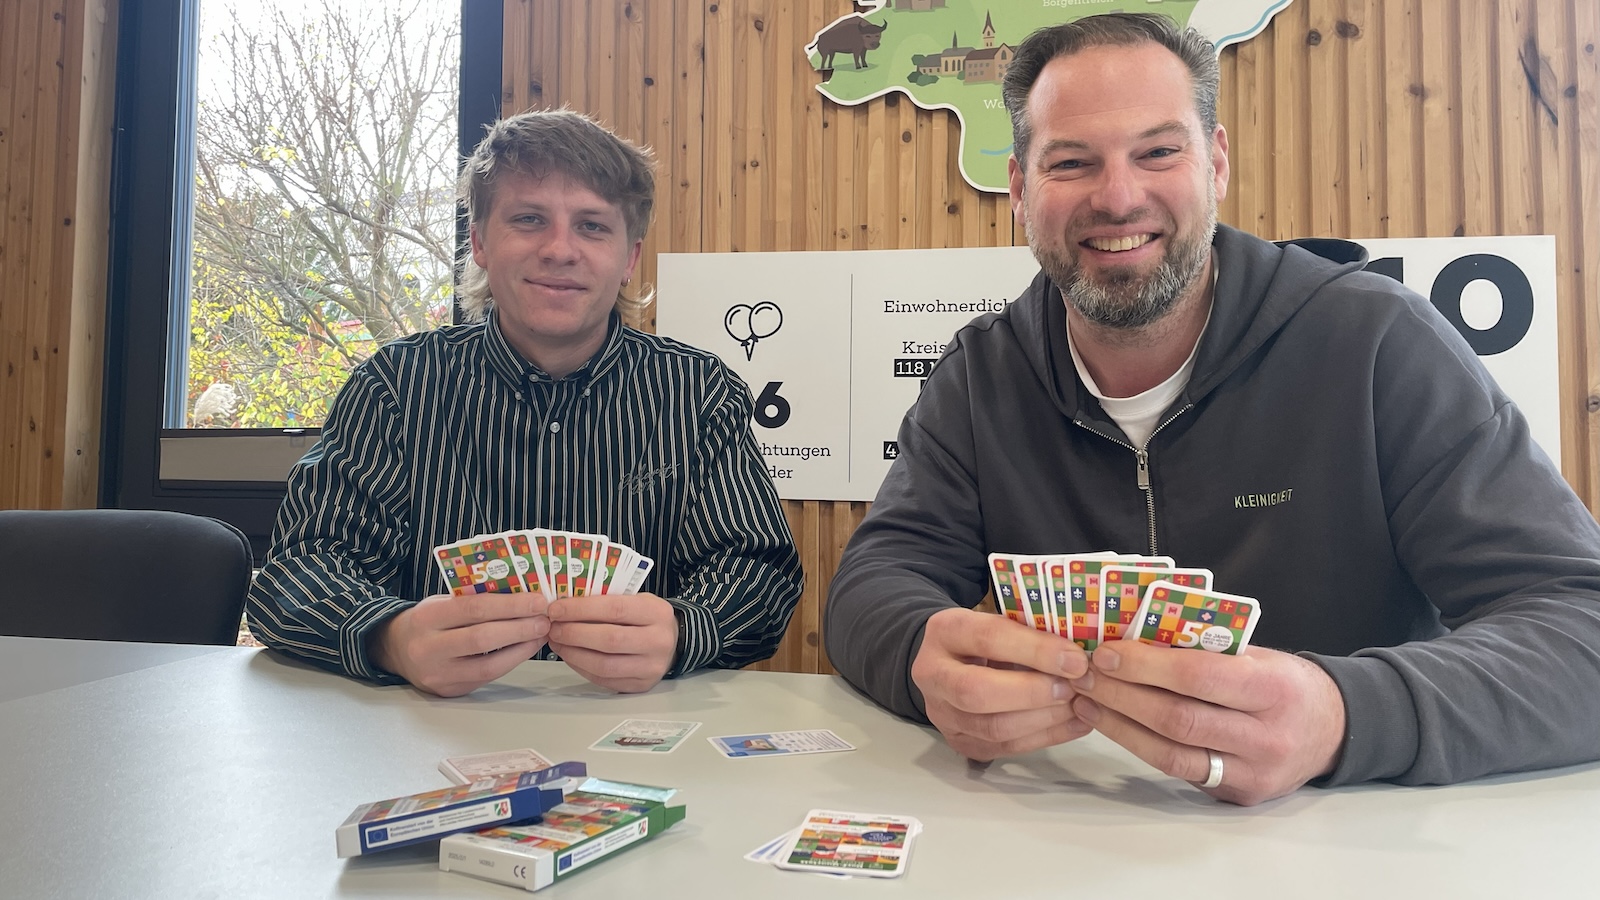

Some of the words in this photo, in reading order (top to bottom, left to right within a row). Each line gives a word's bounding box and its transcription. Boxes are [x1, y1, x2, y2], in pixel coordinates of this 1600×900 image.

[902, 341, 947, 354] Kreis
[896, 361, 925, 375] 118
[753, 381, 791, 429] 6
[759, 442, 832, 461] htungen
[886, 443, 897, 458] 4
